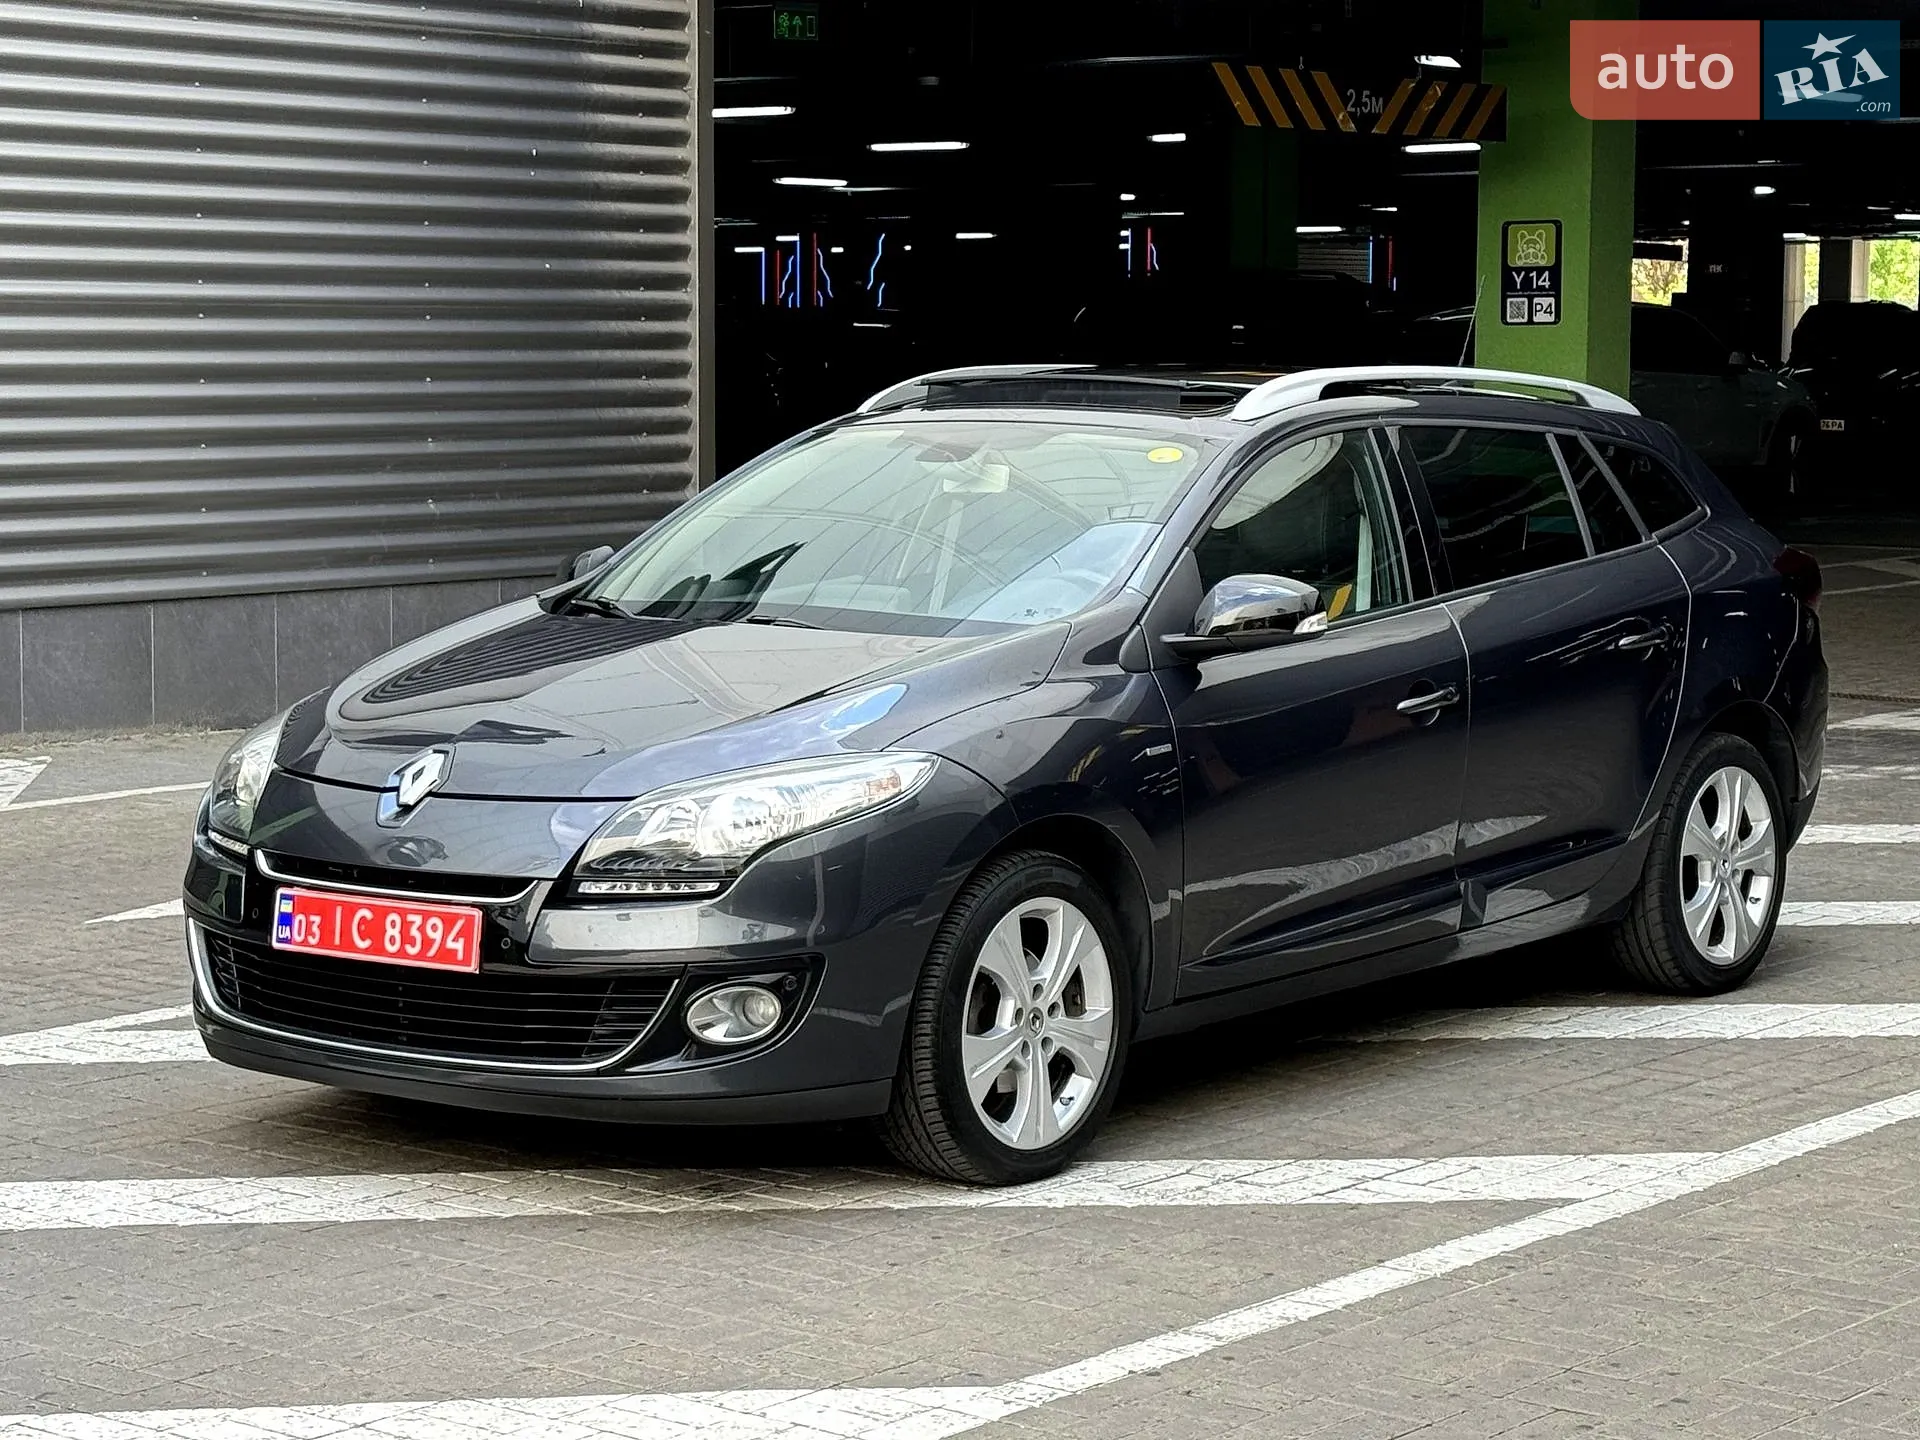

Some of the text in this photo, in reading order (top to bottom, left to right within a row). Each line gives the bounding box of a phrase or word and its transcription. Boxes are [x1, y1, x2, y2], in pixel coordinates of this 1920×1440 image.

[1511, 270, 1551, 290] Y 14
[1534, 302, 1554, 318] P4
[278, 924, 292, 940] UA
[293, 913, 322, 946] 03
[383, 912, 467, 961] 8394
